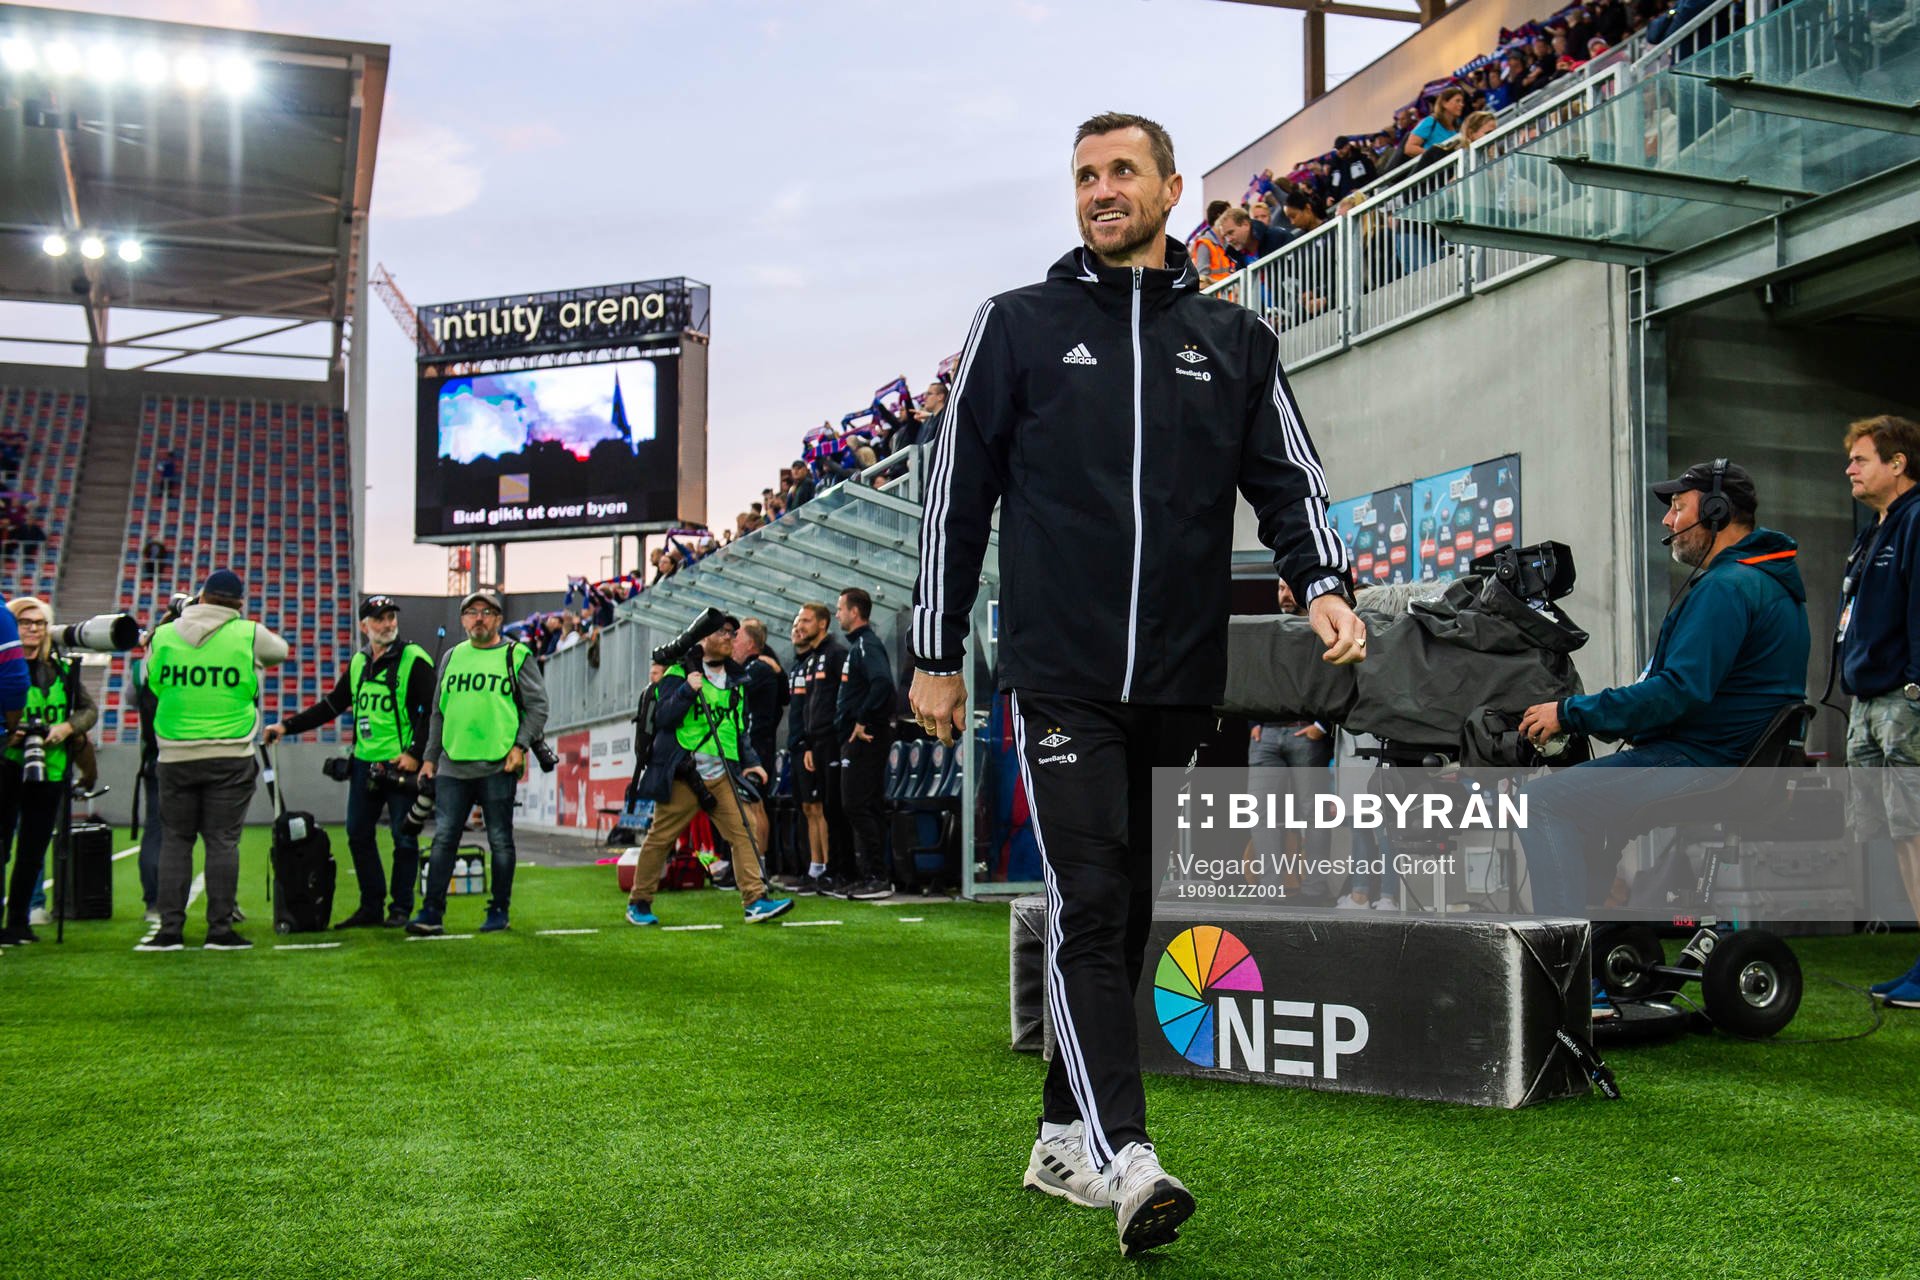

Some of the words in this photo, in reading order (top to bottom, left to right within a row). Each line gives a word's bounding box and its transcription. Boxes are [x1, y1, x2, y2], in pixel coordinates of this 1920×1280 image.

[432, 296, 544, 341] intility
[559, 292, 665, 328] arena
[1062, 355, 1098, 365] adidas
[453, 508, 486, 525] Bud
[487, 506, 524, 525] gikk
[526, 504, 545, 520] ut
[547, 503, 584, 519] over
[587, 501, 628, 518] byen
[160, 665, 241, 688] PHOTO
[446, 672, 514, 697] PHOTO
[1218, 996, 1369, 1080] NEP
[1556, 1029, 1583, 1058] ediatec
